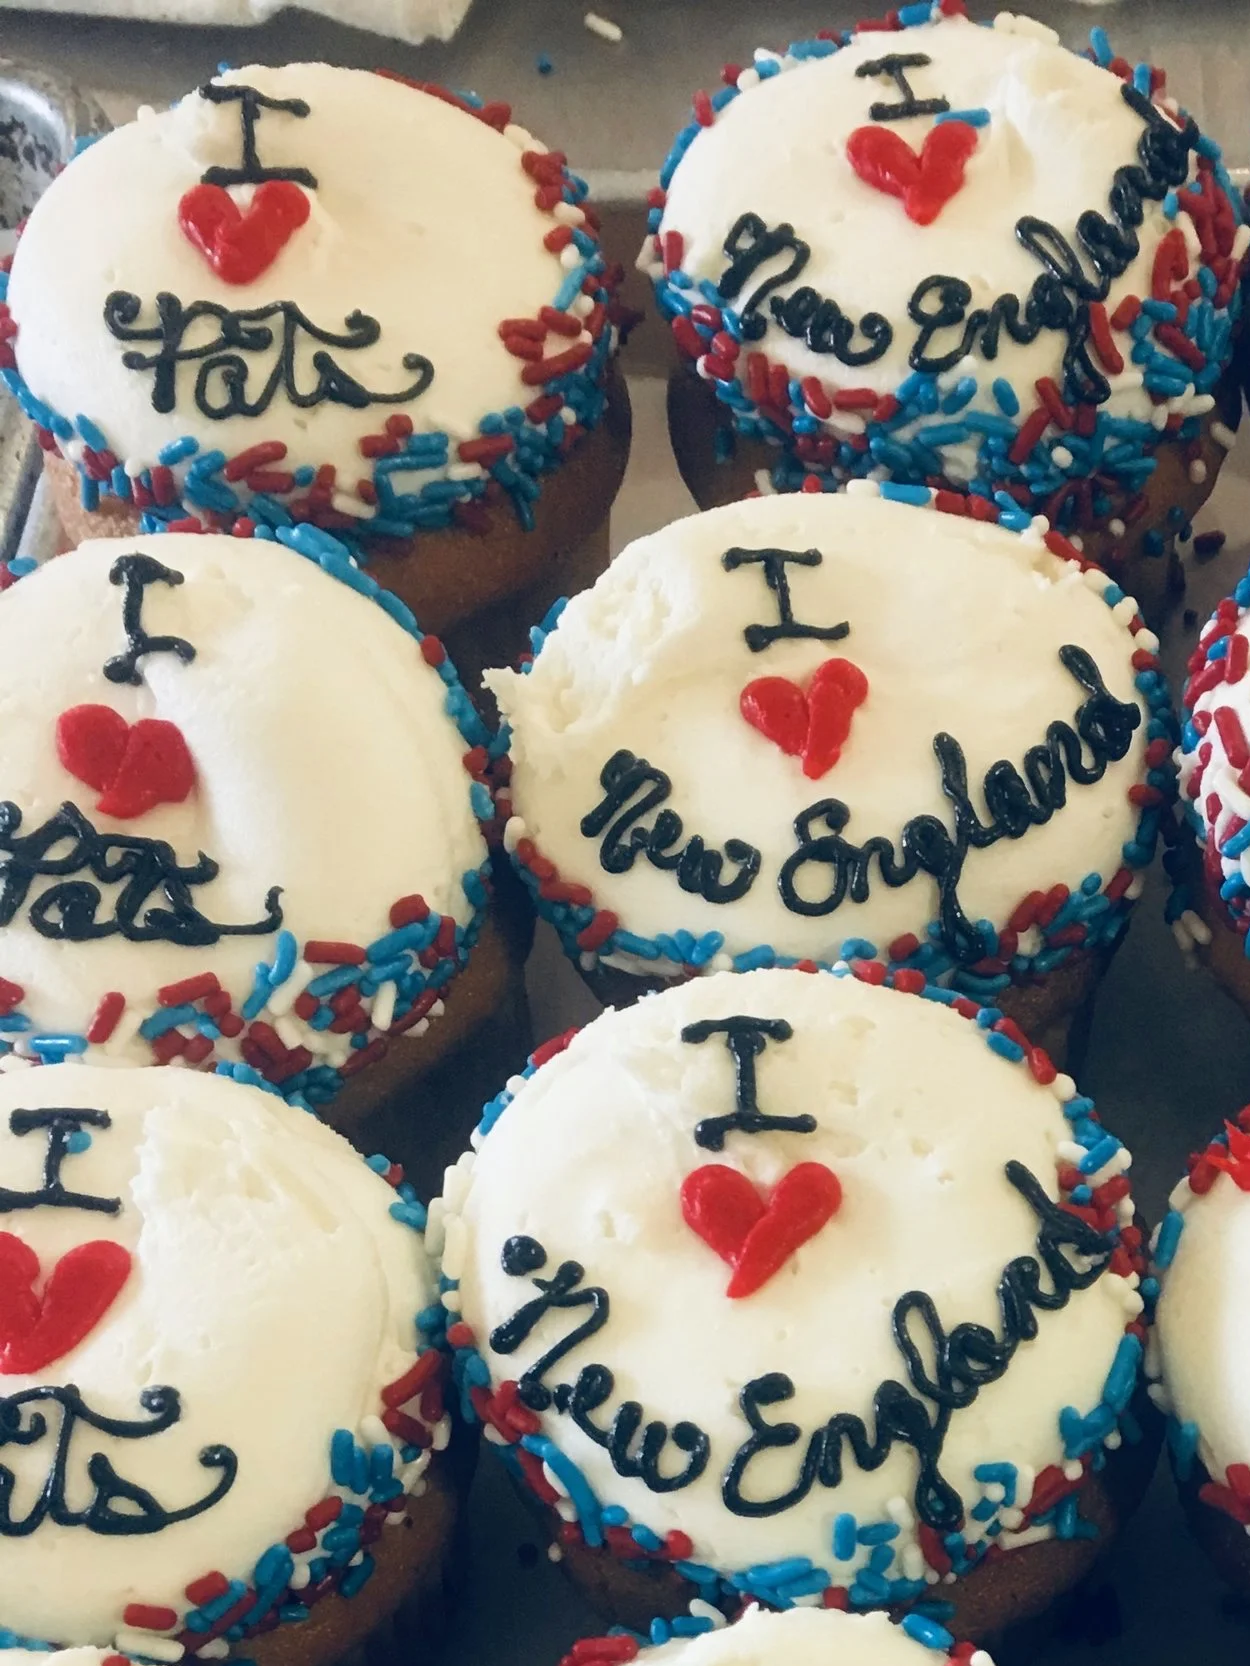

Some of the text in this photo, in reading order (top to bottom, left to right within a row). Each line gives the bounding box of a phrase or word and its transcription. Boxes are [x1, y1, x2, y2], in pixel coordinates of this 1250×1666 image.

[200, 83, 318, 190] I
[855, 52, 950, 122] I
[718, 212, 893, 366] New
[103, 552, 196, 686] I
[722, 546, 850, 652] I
[580, 644, 1141, 964] New England
[681, 1015, 817, 1151] I
[0, 1108, 121, 1215] I
[489, 1160, 1115, 1530] New England
